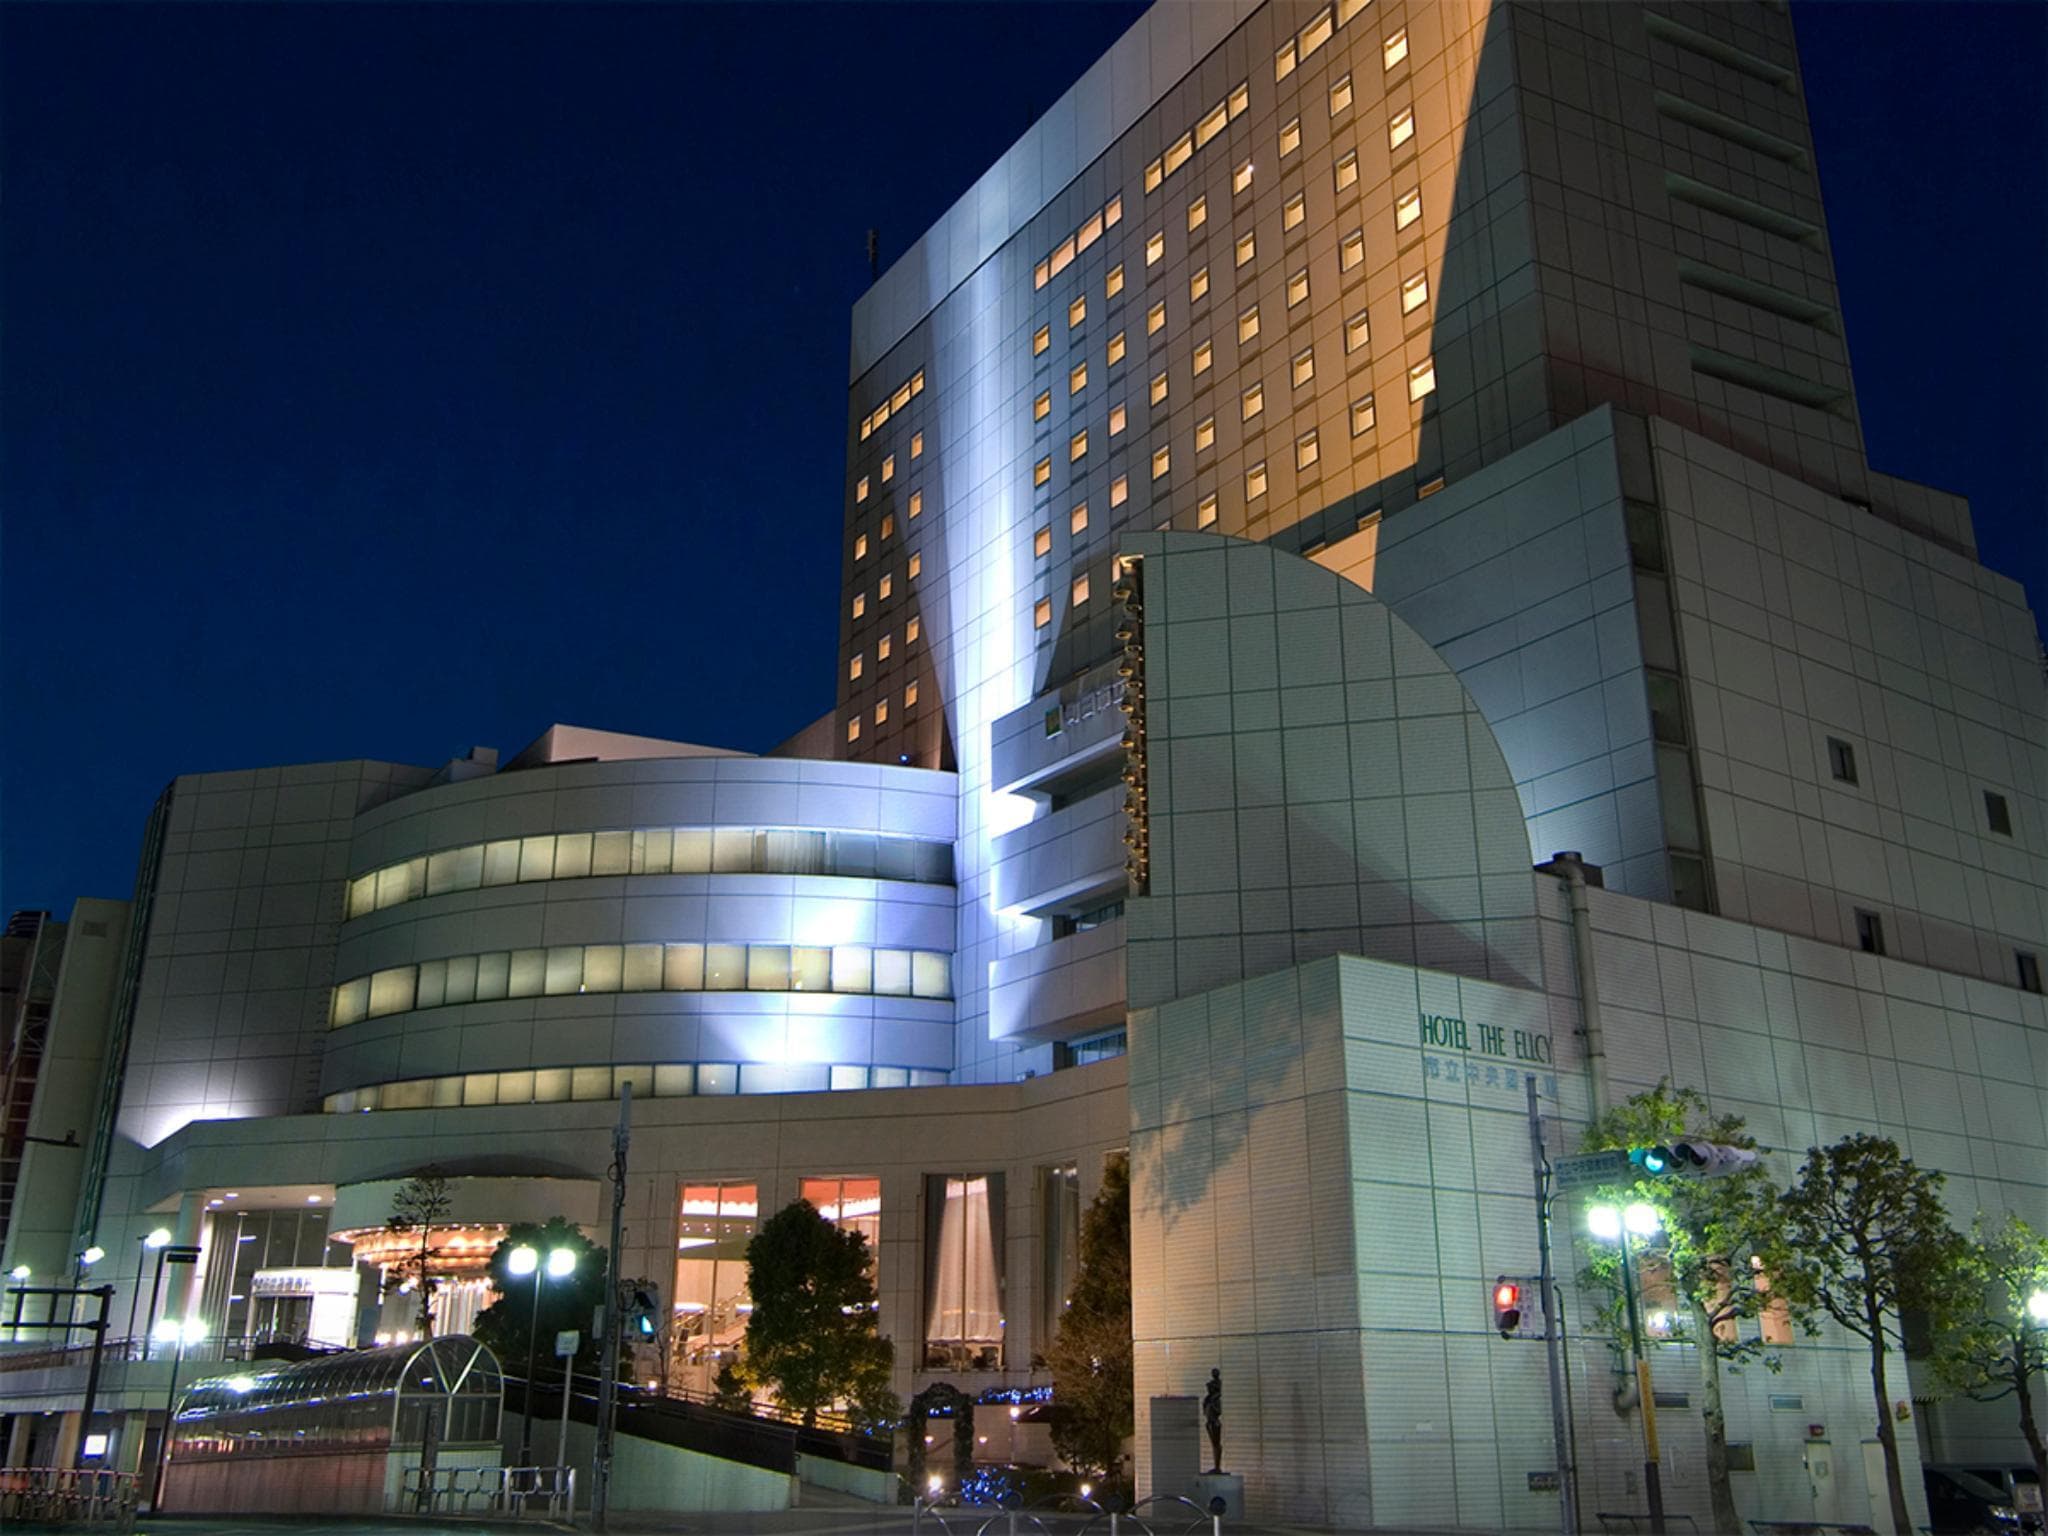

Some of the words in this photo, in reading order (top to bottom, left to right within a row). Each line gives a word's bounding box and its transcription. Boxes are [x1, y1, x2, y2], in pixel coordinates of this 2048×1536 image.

[1422, 1014, 1471, 1050] HOTEL
[1478, 1024, 1507, 1056] THE
[1514, 1031, 1554, 1064] ELLCY
